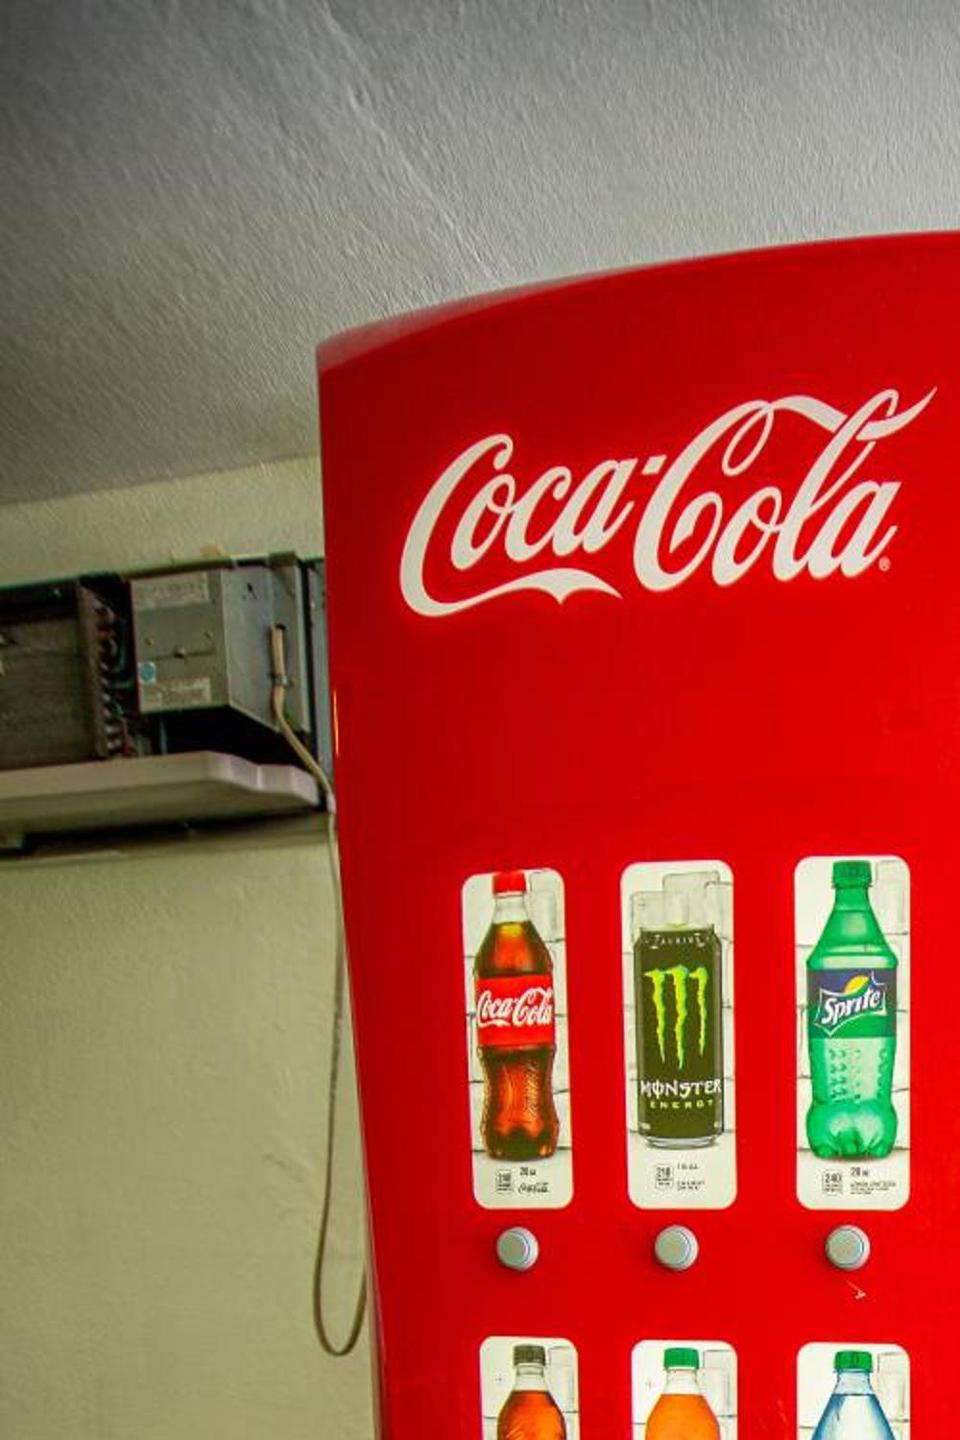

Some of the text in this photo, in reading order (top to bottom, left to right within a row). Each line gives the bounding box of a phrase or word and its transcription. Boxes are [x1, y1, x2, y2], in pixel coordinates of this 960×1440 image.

[400, 386, 938, 617] Coca-Cola
[477, 987, 552, 1028] Coca-Cola
[821, 987, 881, 1026] Sprite
[641, 1079, 722, 1099] MONSTER
[650, 1099, 714, 1109] ENERGY
